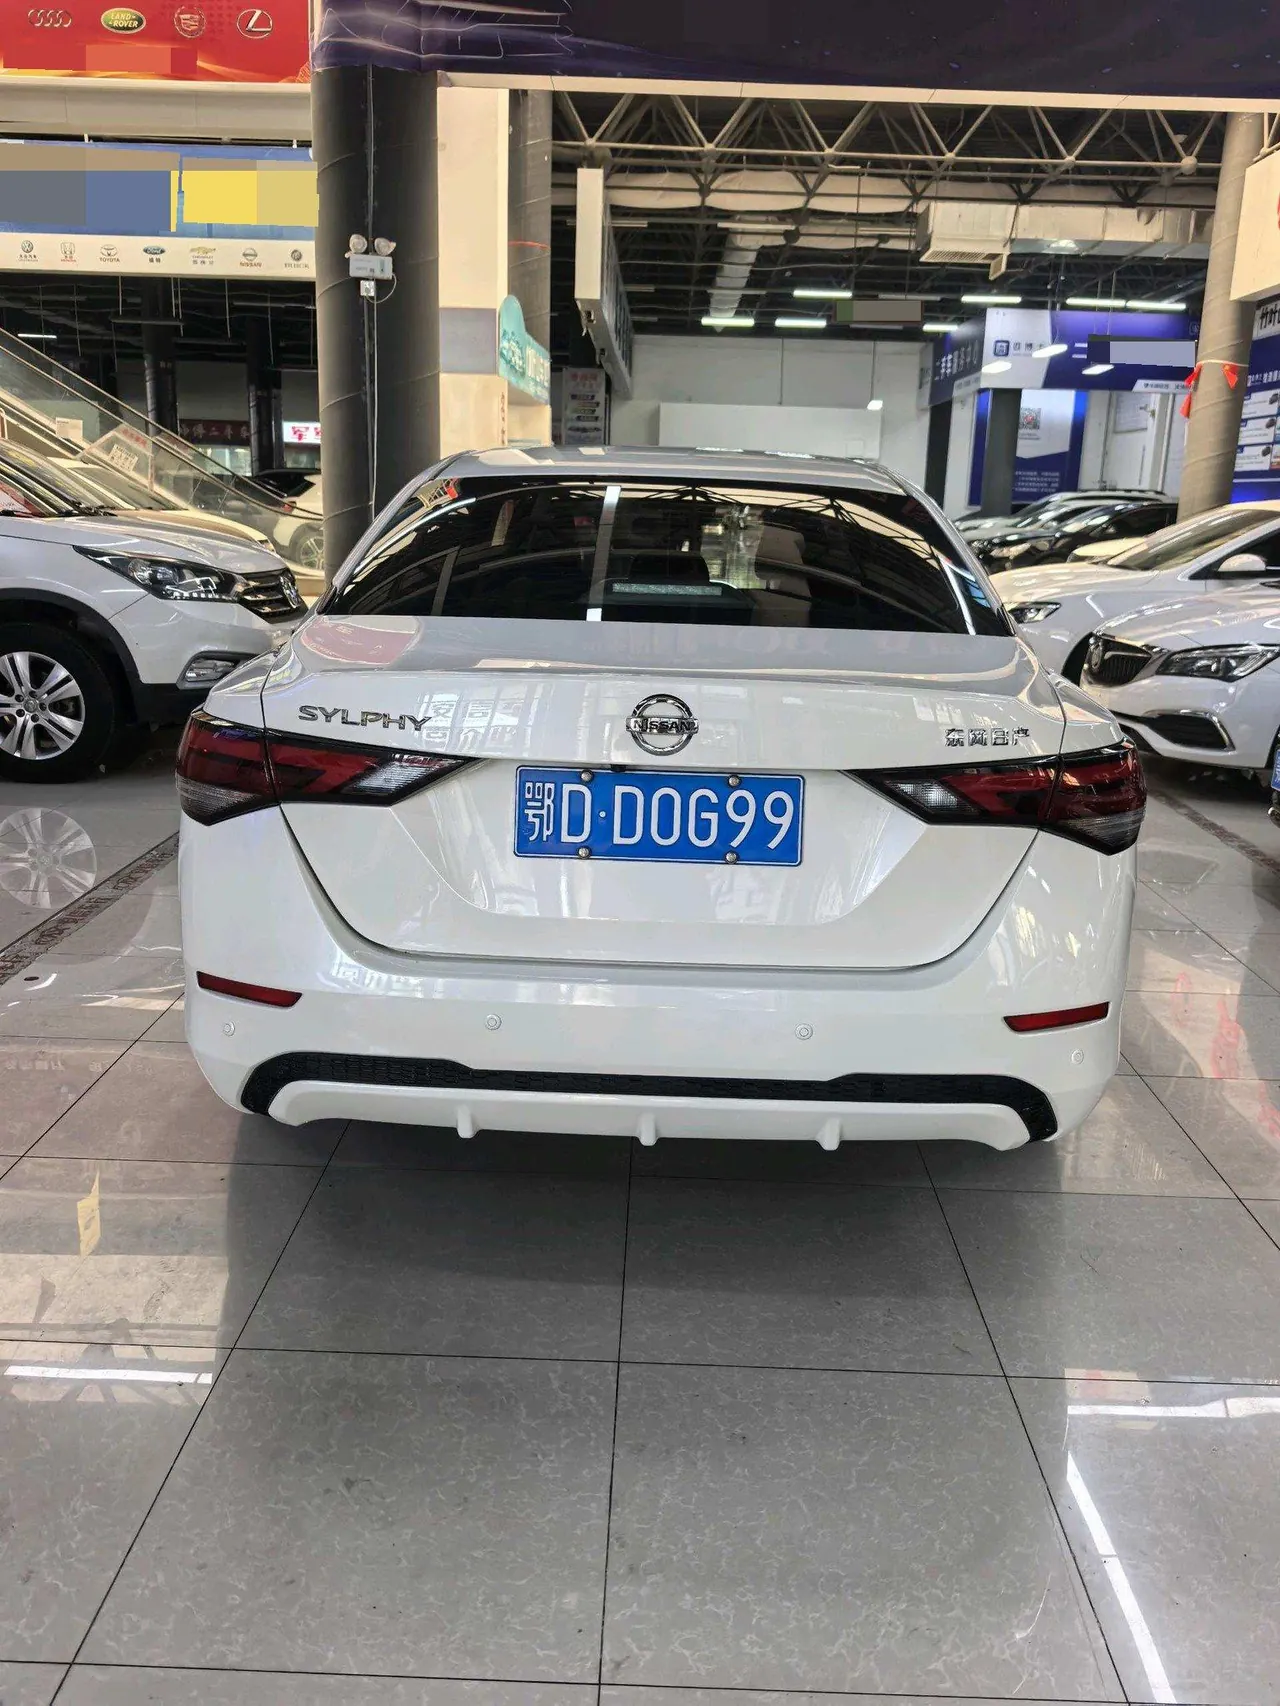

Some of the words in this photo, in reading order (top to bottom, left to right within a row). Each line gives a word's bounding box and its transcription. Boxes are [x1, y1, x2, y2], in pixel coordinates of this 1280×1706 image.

[298, 704, 433, 732] SYLPHY
[633, 719, 694, 733] NISSAN
[944, 726, 1030, 747] 东风日产
